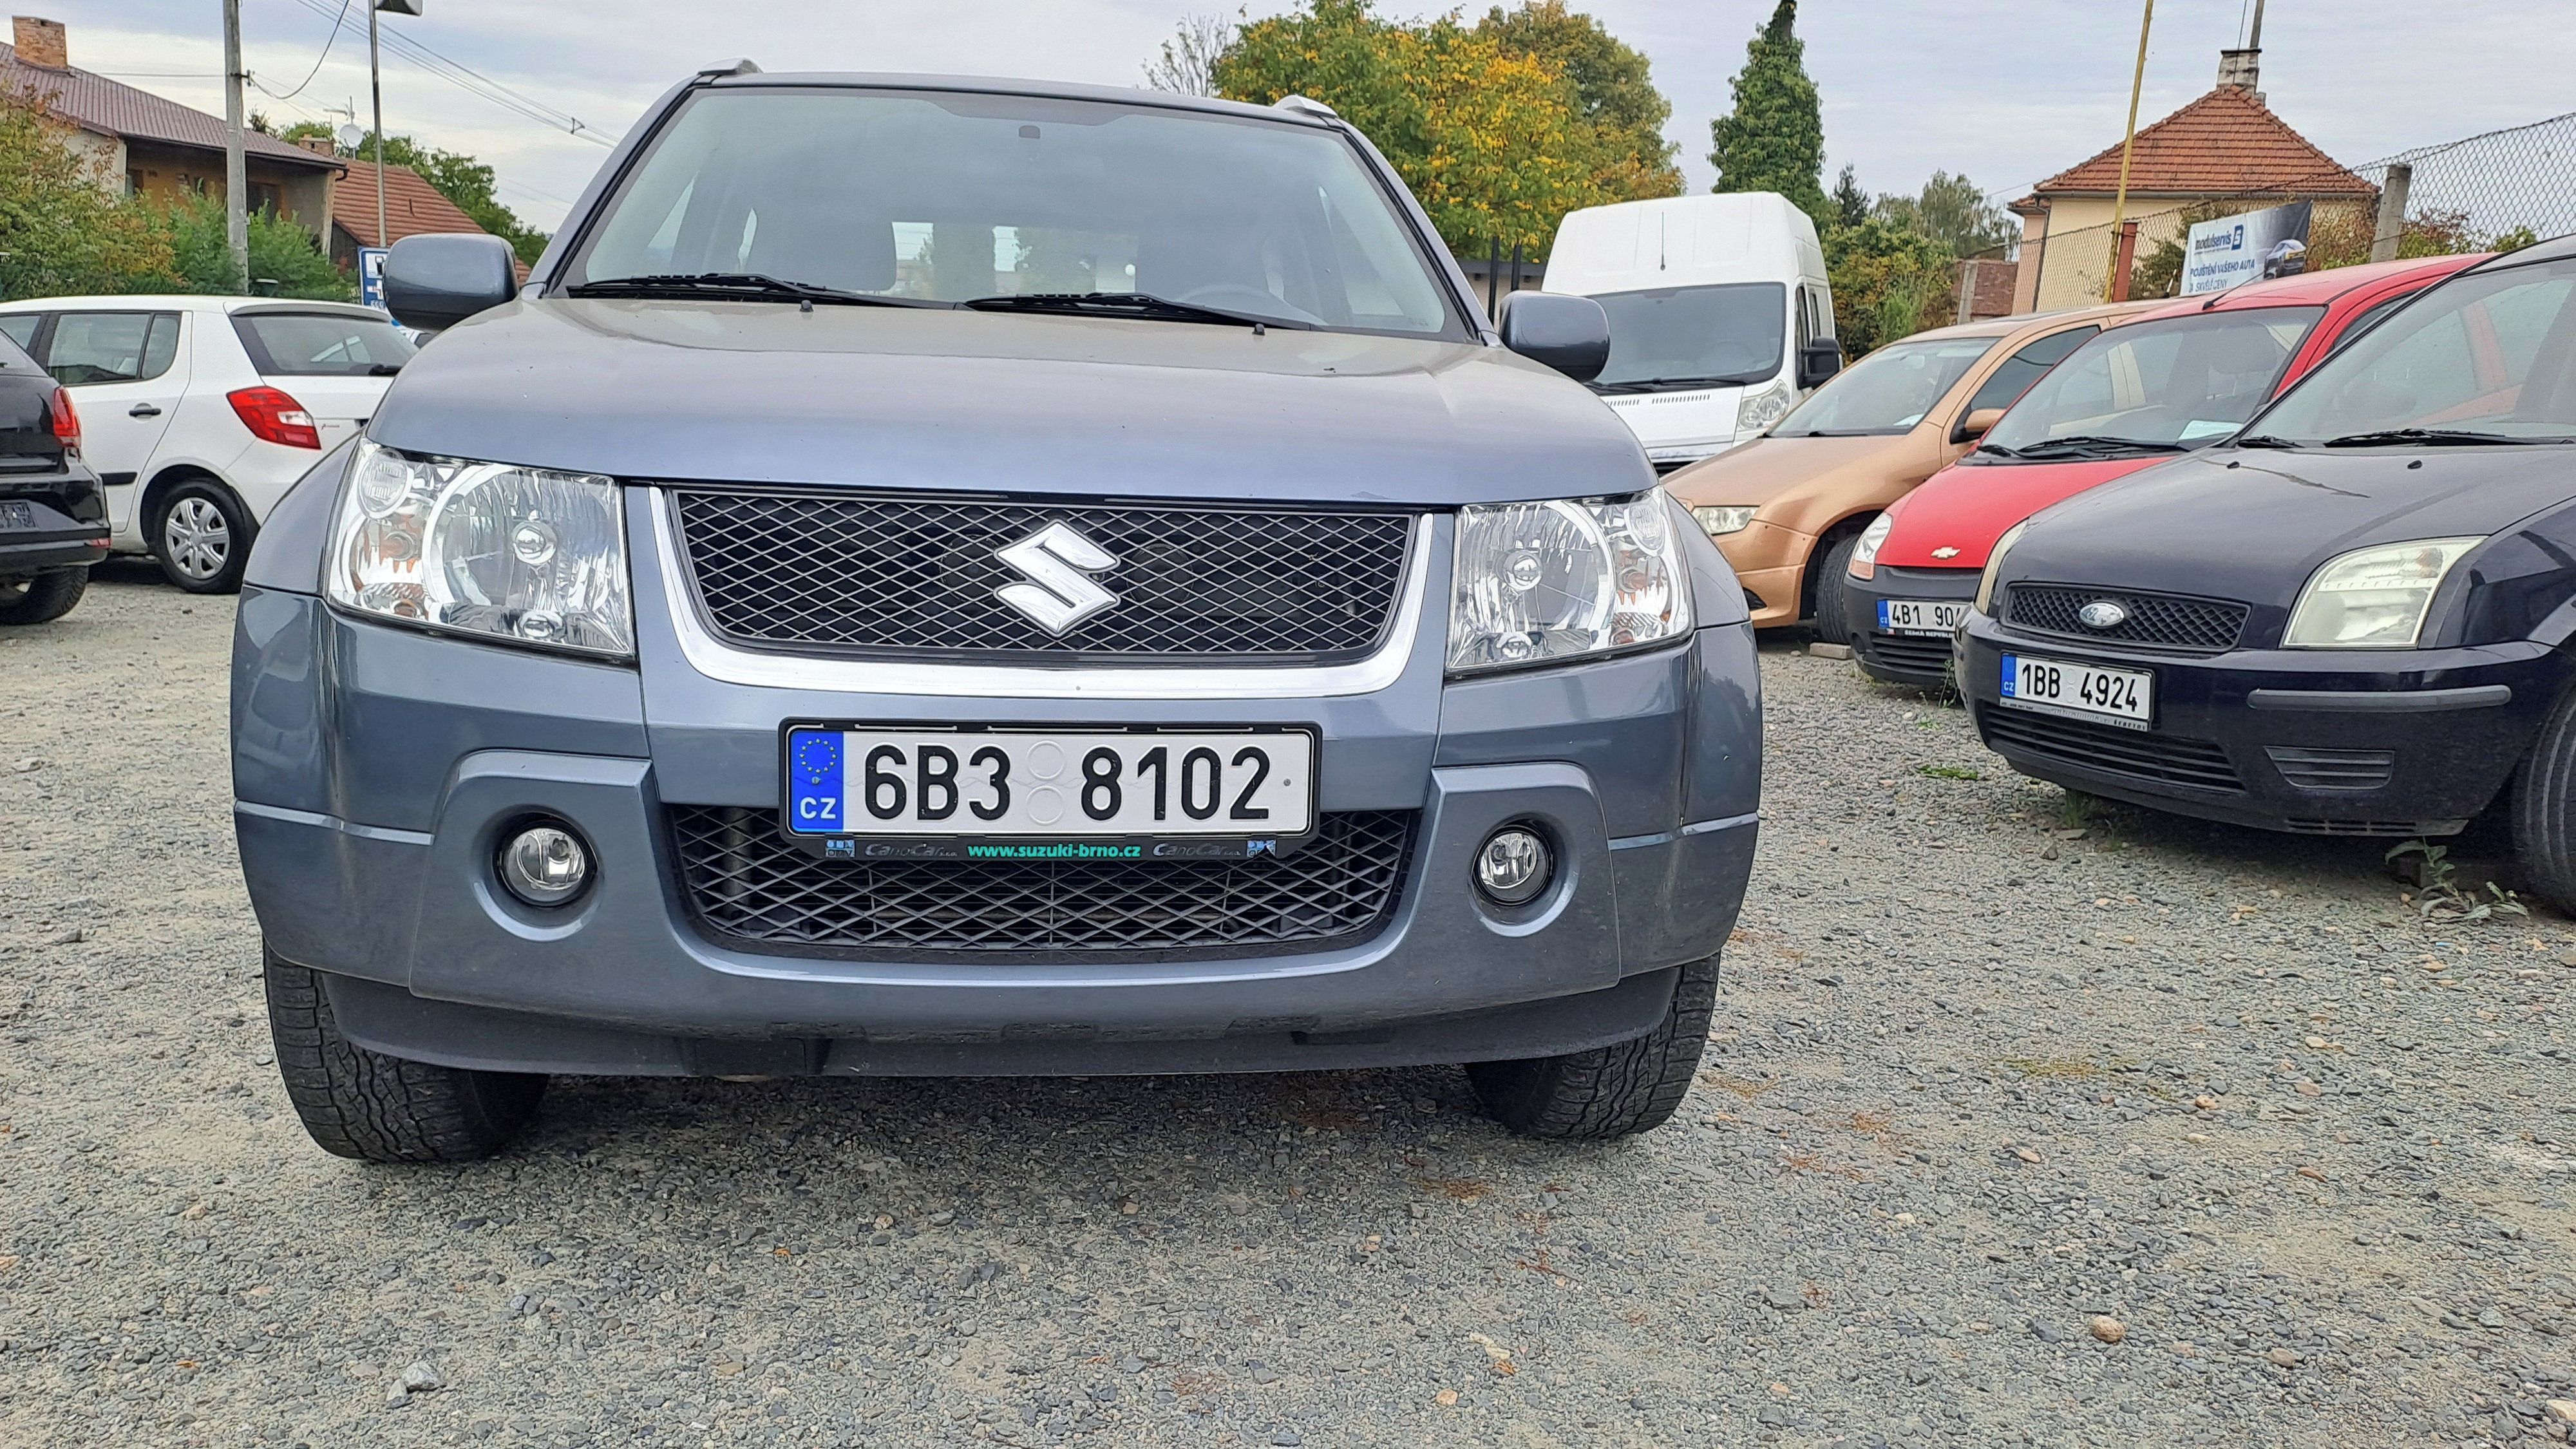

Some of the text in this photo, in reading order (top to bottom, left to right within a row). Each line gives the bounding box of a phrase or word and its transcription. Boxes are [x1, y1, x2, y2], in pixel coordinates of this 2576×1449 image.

[2239, 258, 2255, 270] AUTA
[1892, 604, 1920, 625] 4B1
[2003, 681, 2014, 692] CZ
[2022, 663, 2137, 712] 1BB 4924
[864, 744, 1271, 820] 6B3 8102
[799, 797, 837, 820] CZ
[967, 844, 1141, 858] www.suzuki-brno.cz
